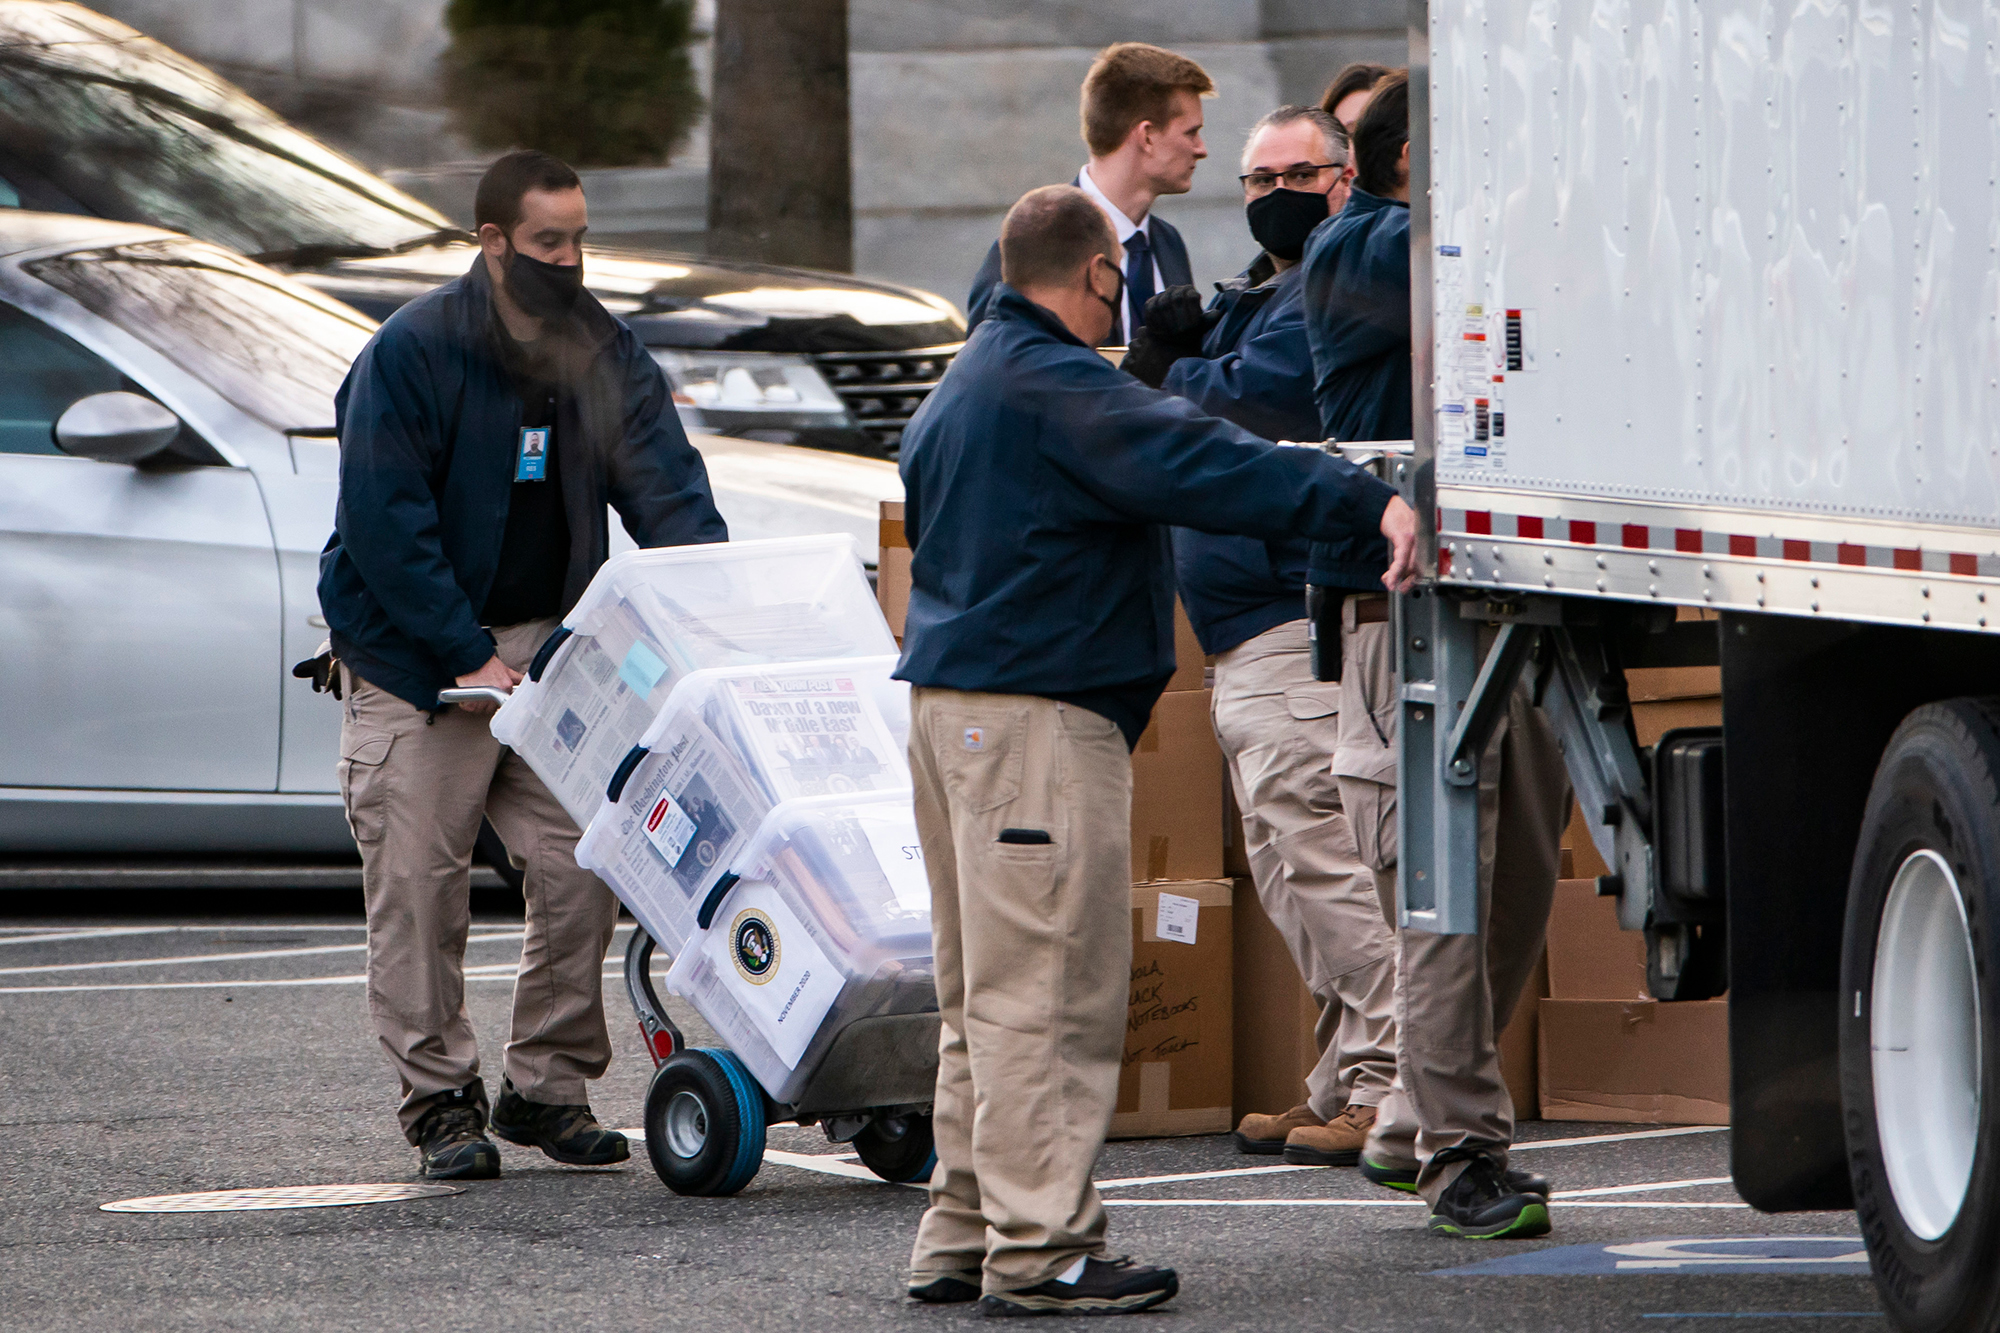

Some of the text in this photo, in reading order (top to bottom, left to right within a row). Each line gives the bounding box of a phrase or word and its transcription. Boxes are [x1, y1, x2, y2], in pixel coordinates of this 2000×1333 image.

[777, 679, 808, 693] YORK
[807, 679, 833, 692] POST
[795, 699, 813, 715] of
[814, 701, 827, 715] a
[827, 700, 862, 714] new
[763, 716, 820, 733] Mddle
[620, 815, 636, 835] The
[630, 758, 674, 816] Washington
[670, 734, 689, 763] Post
[777, 969, 811, 1024] NOVEMBER 2020
